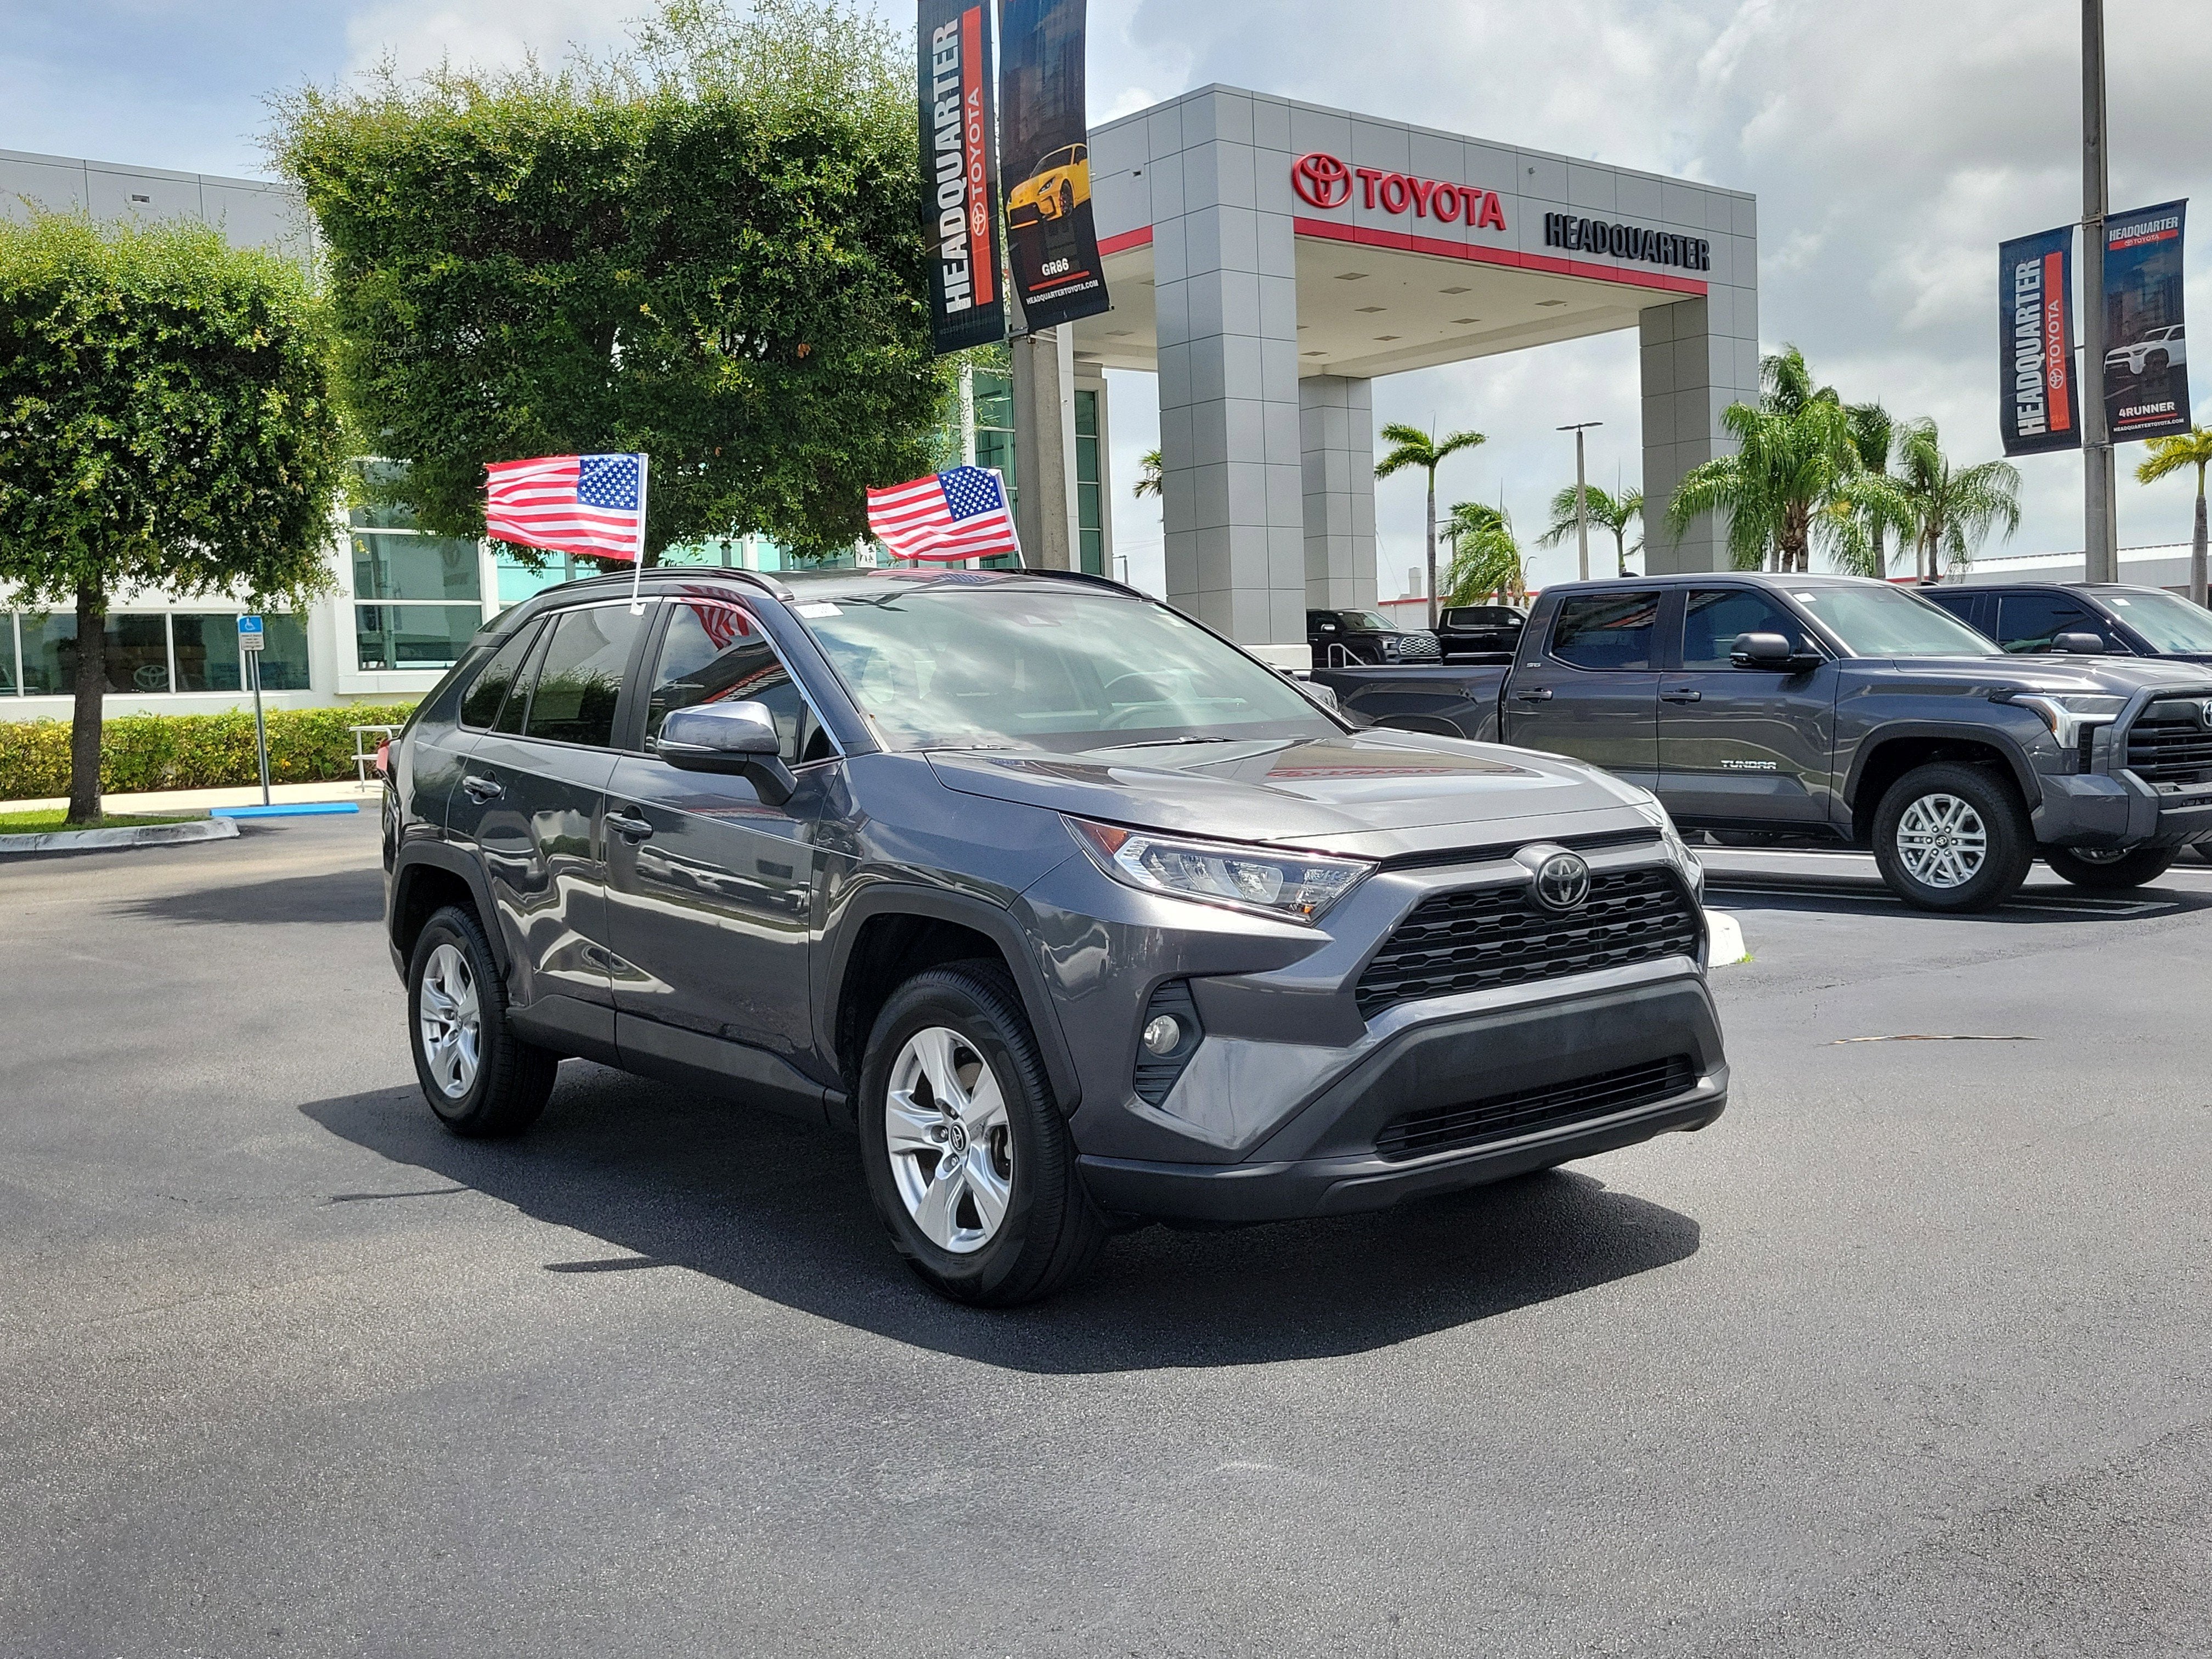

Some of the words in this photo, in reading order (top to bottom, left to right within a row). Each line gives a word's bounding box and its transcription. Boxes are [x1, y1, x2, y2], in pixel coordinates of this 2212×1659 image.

[968, 87, 983, 200] TOYOTA
[933, 18, 972, 314] HEADQUARTER
[1356, 168, 1506, 230] TOYOTA
[1545, 212, 1710, 271] HEADQUARTER
[2109, 216, 2179, 242] HEADQUARTER
[2134, 234, 2159, 244] TOYOTA
[1042, 258, 1069, 276] GR86
[1026, 279, 1099, 305] HEADQUARTERTOYOTA.COM
[2048, 299, 2060, 368] TOYOTA
[2015, 258, 2046, 436] HEADQUARTER
[2118, 402, 2175, 417] 4RUNNER
[2113, 418, 2184, 432] HEADQUARTERTOYOTA.COM
[1720, 760, 1777, 769] TUNDRA
